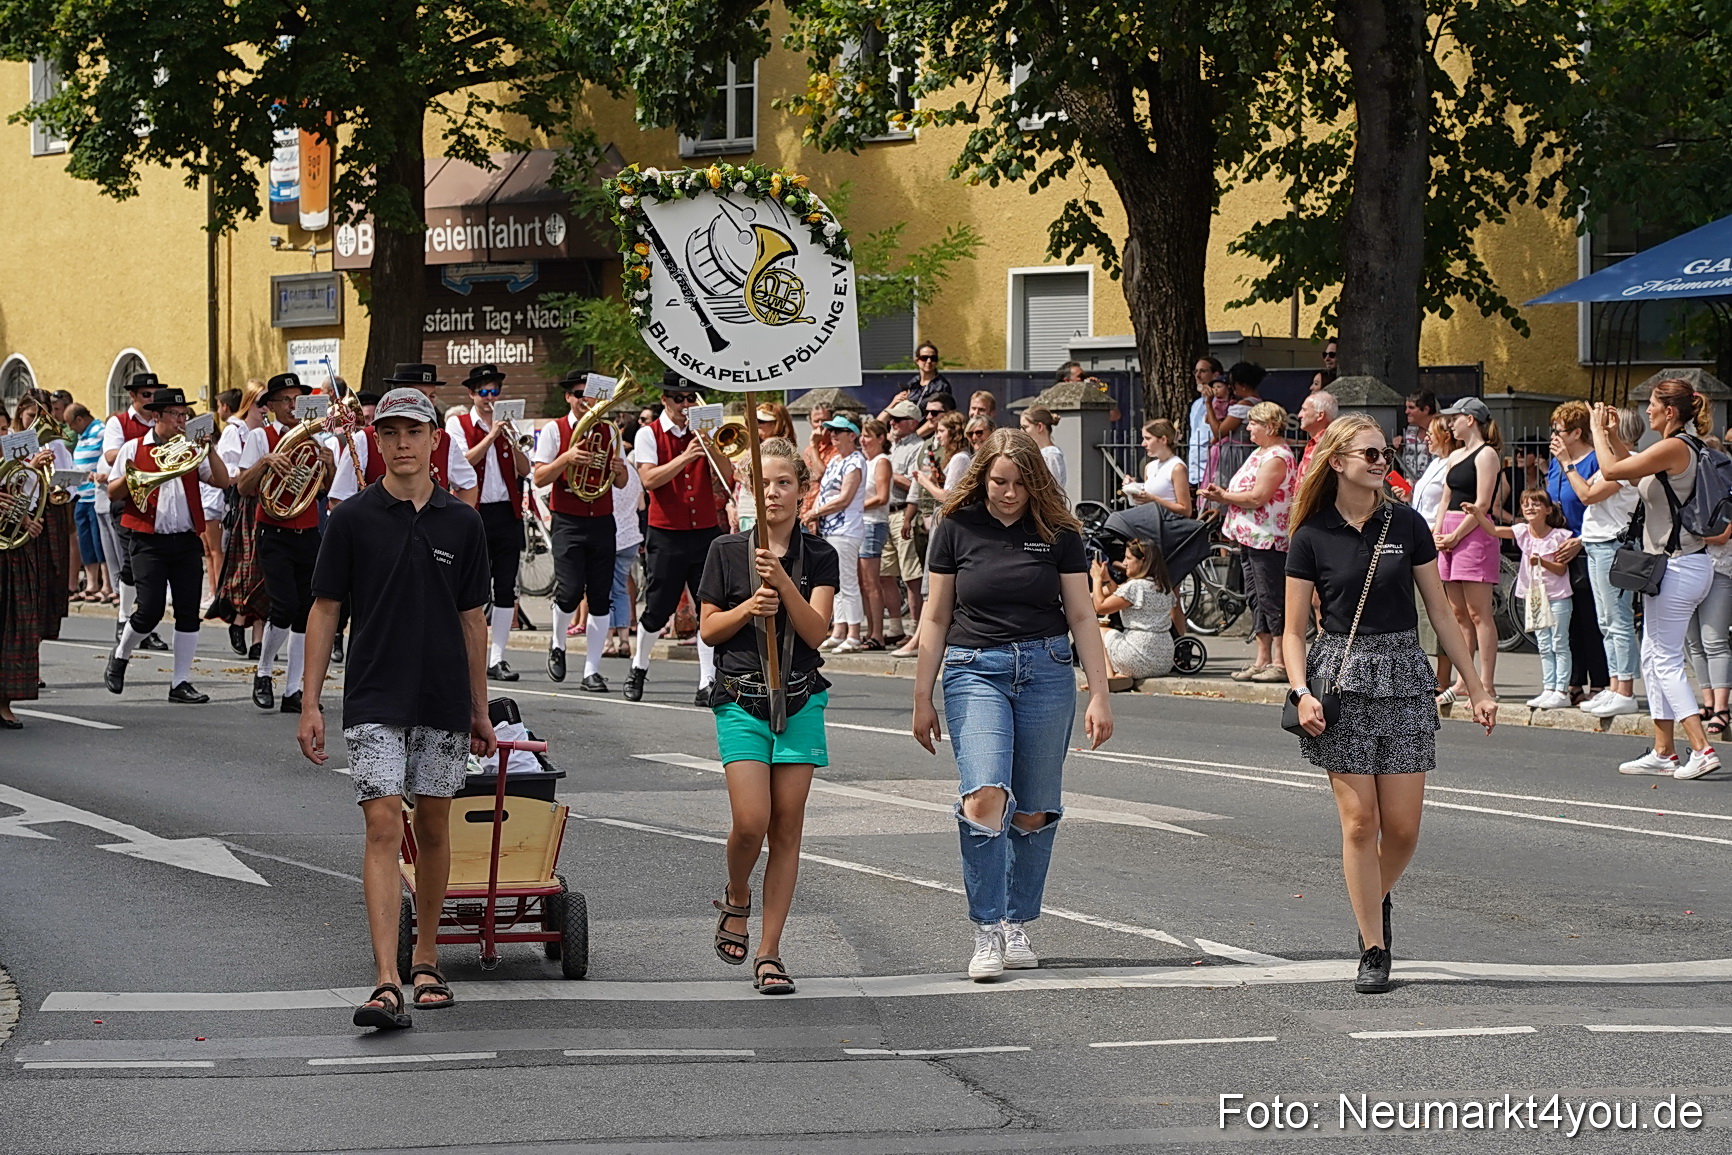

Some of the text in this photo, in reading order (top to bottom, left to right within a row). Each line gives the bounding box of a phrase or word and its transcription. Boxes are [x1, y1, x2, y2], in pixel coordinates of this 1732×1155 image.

[1683, 257, 1732, 275] GA
[423, 306, 475, 332] sfahrt
[482, 306, 511, 335] Tag
[446, 337, 534, 364] freihalten!
[648, 321, 783, 383] BLASKAPELLE
[781, 300, 845, 373] PÖLLING
